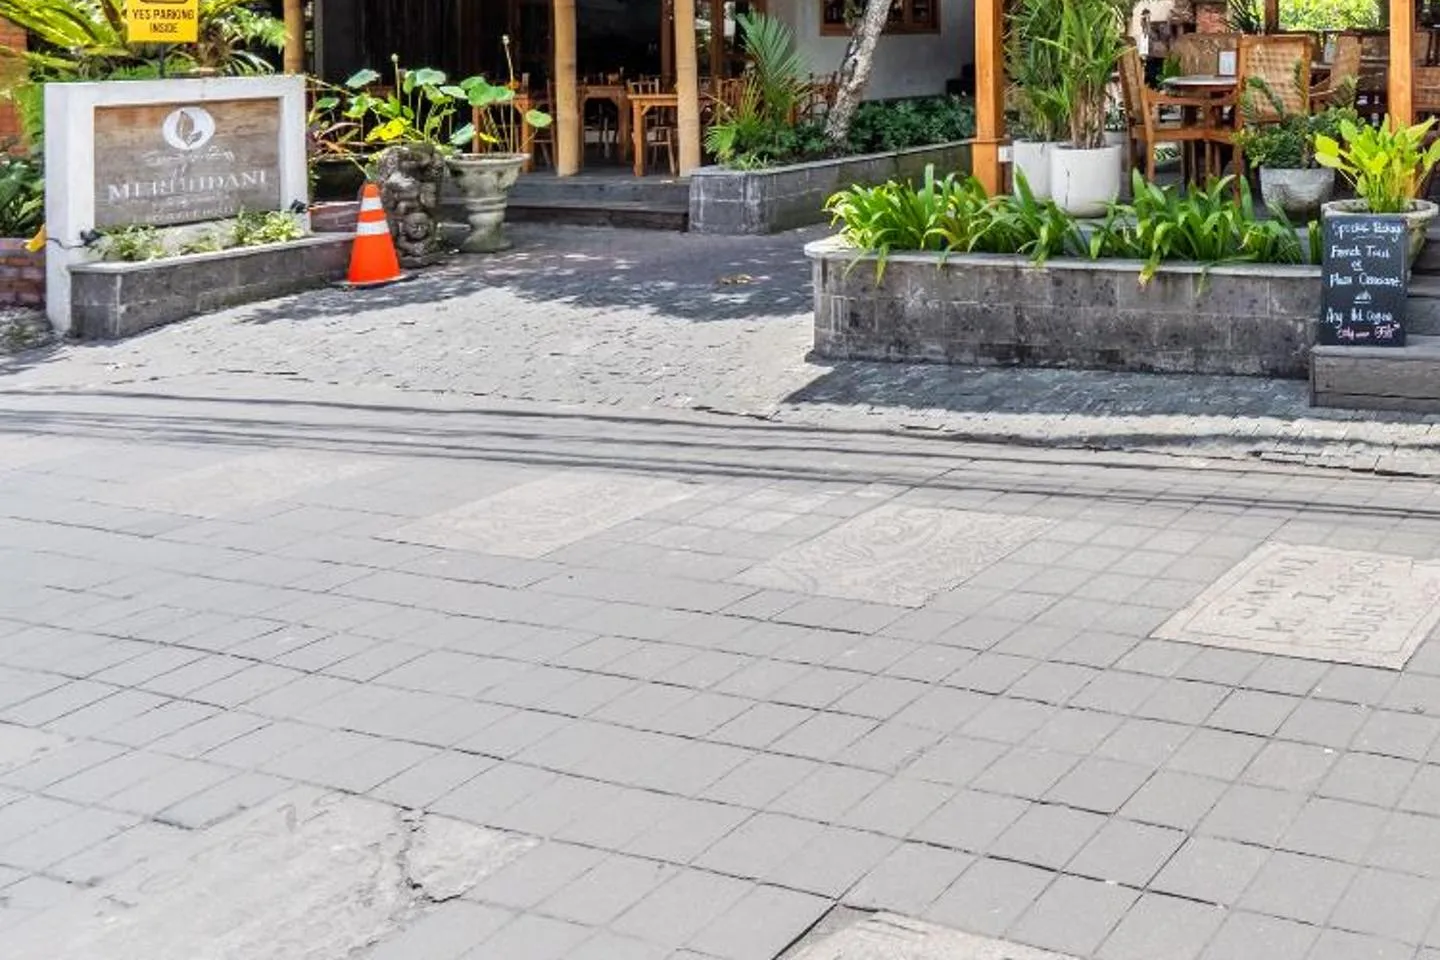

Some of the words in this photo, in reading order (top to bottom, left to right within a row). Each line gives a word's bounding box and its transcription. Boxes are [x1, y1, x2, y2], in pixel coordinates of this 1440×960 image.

[132, 8, 151, 20] YES
[153, 8, 195, 20] PARKING
[150, 22, 179, 33] INSIDE
